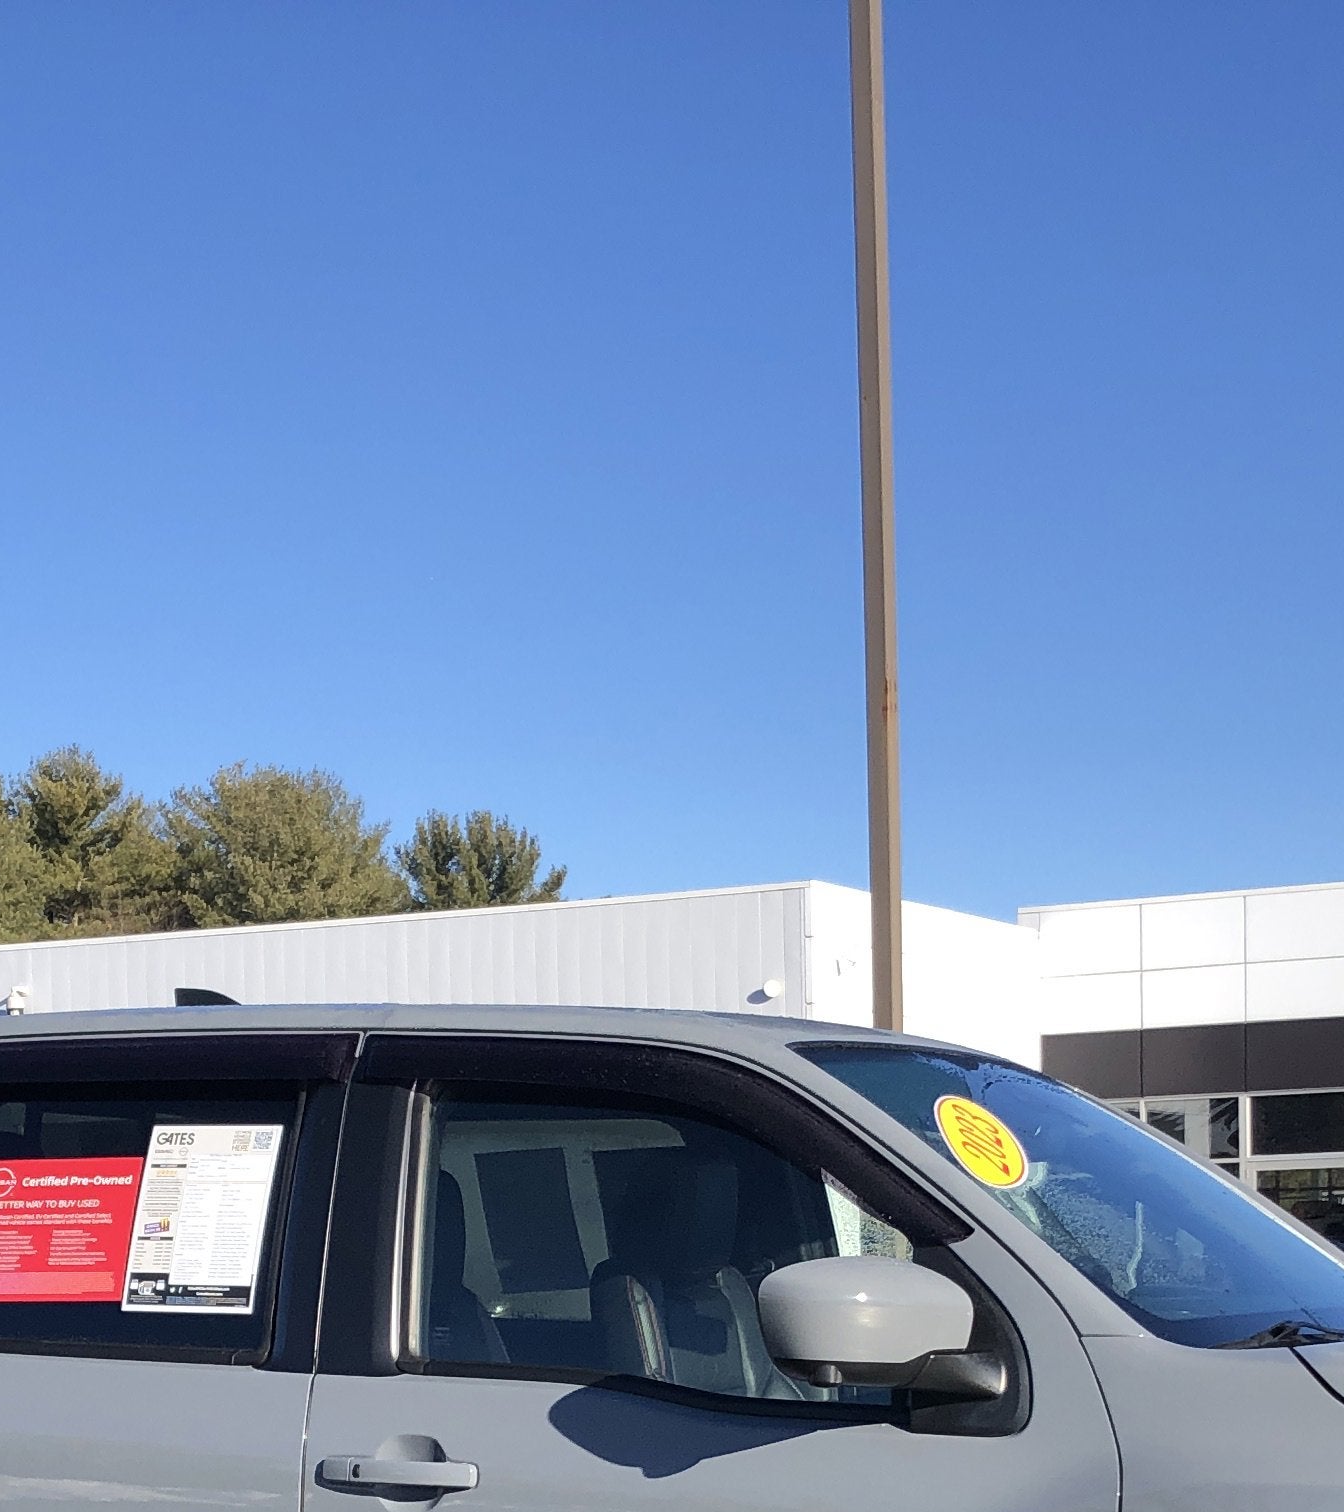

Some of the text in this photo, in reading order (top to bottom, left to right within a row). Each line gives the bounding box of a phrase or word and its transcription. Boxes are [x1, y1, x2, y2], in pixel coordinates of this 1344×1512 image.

[157, 1132, 195, 1146] GATES
[952, 1103, 1010, 1177] 2023
[22, 1174, 133, 1187] Certified Pre-Owned
[26, 1200, 44, 1209] WAY
[45, 1200, 57, 1208] TO
[58, 1199, 75, 1208] BUY
[77, 1199, 100, 1207] USED
